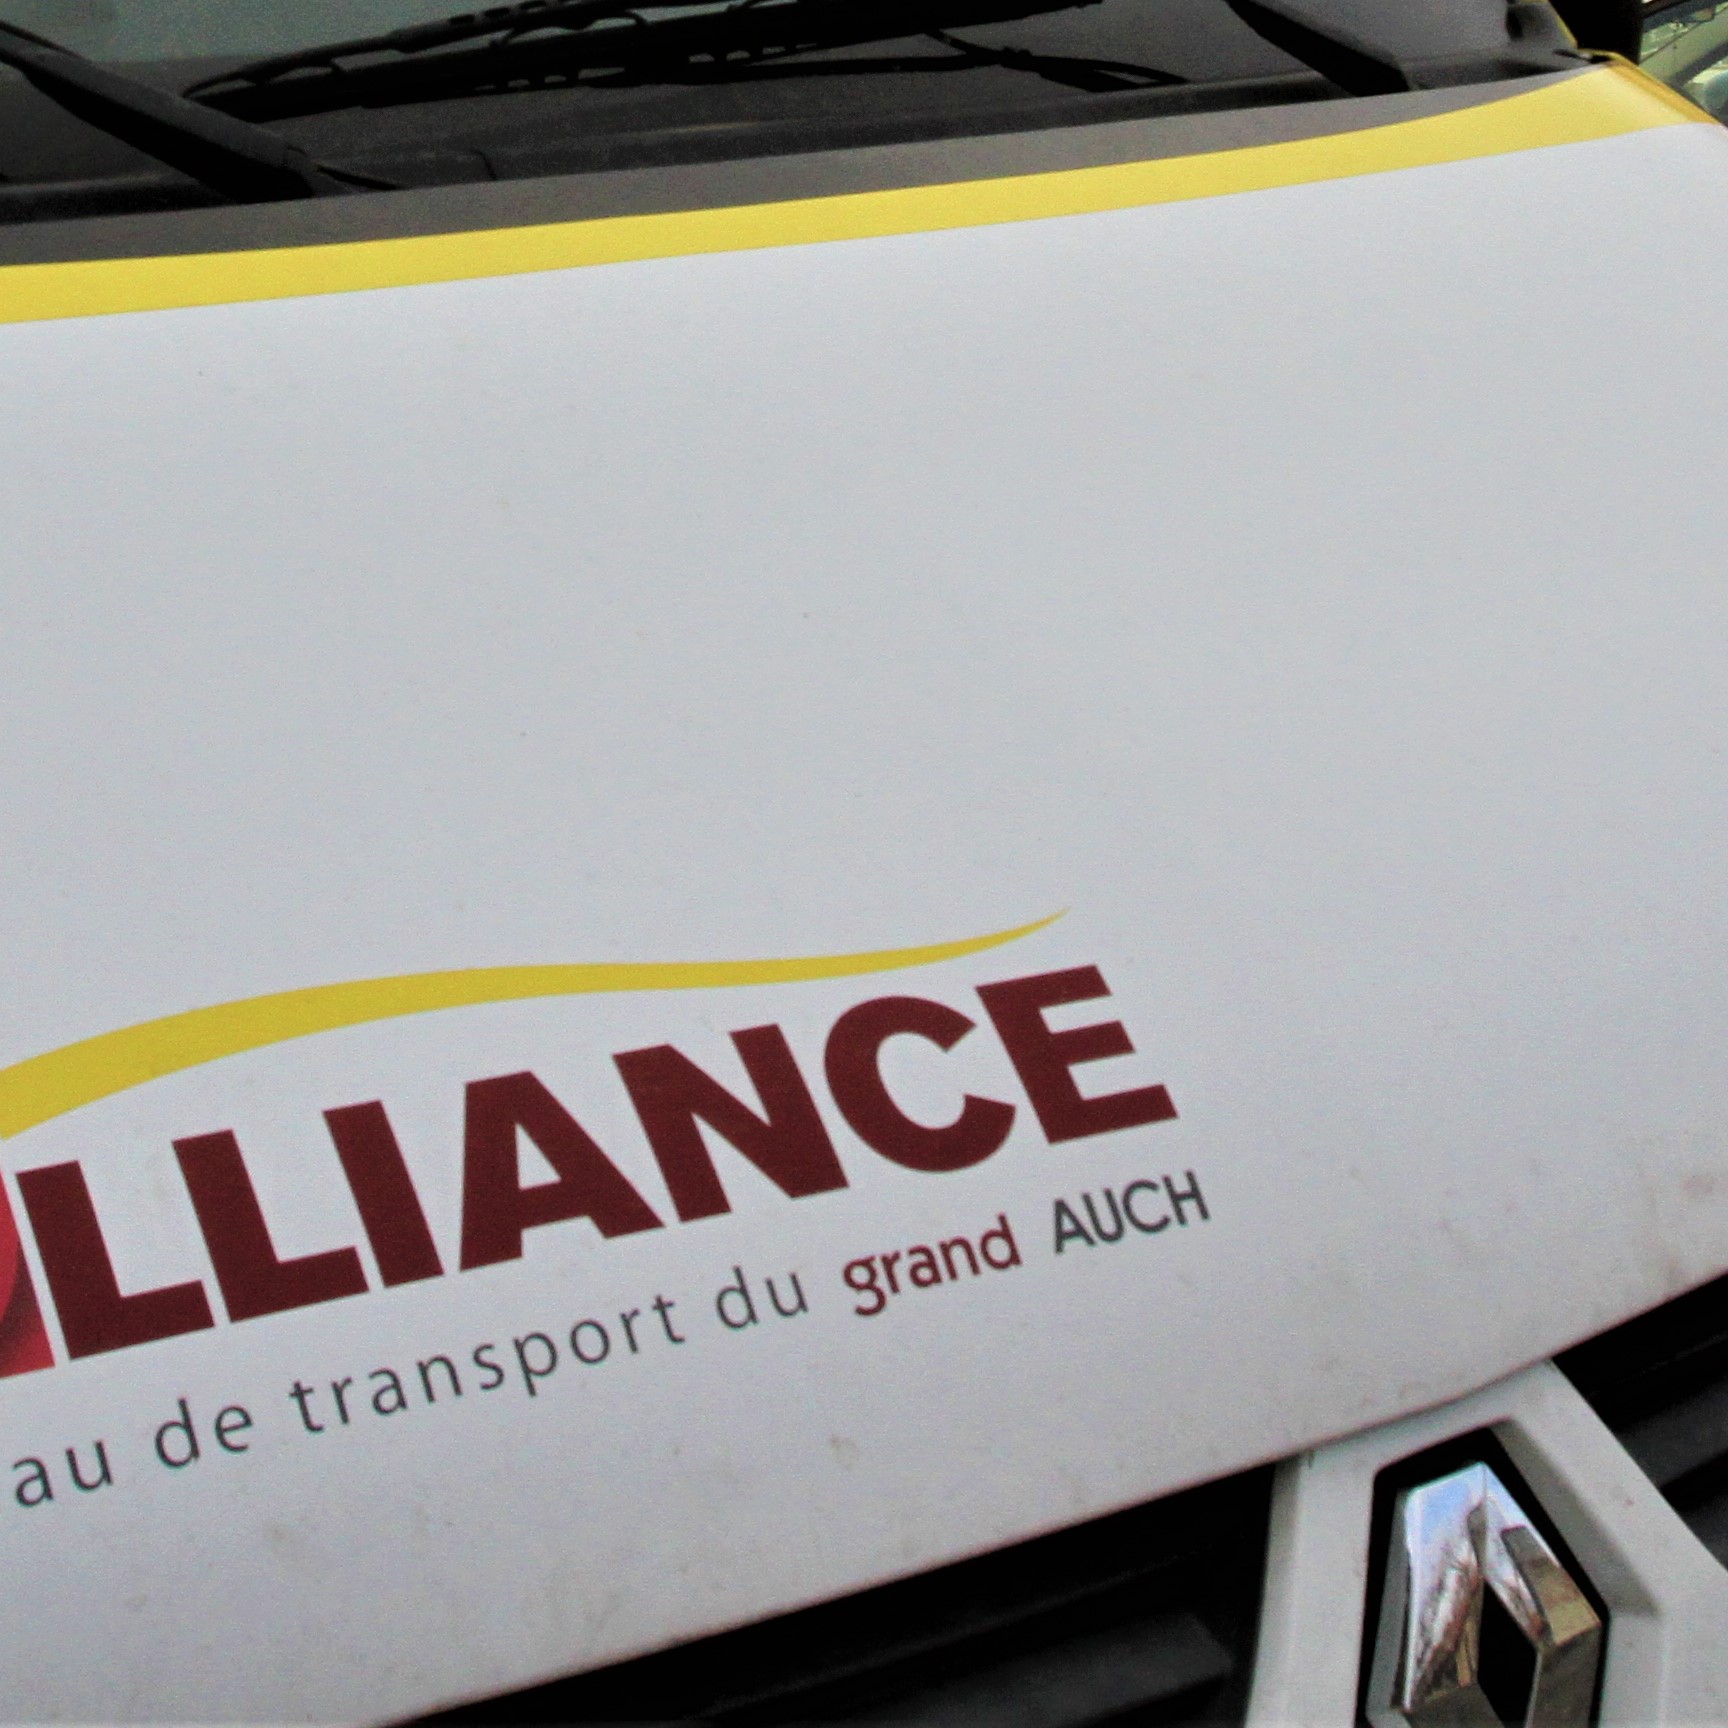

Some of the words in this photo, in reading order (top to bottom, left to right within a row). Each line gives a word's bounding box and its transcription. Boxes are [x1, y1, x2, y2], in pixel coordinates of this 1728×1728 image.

[153, 1394, 255, 1472] de
[287, 1290, 688, 1442] transport
[714, 1265, 810, 1335] du
[839, 1213, 1024, 1318] grand
[1048, 1169, 1212, 1259] AUCH
